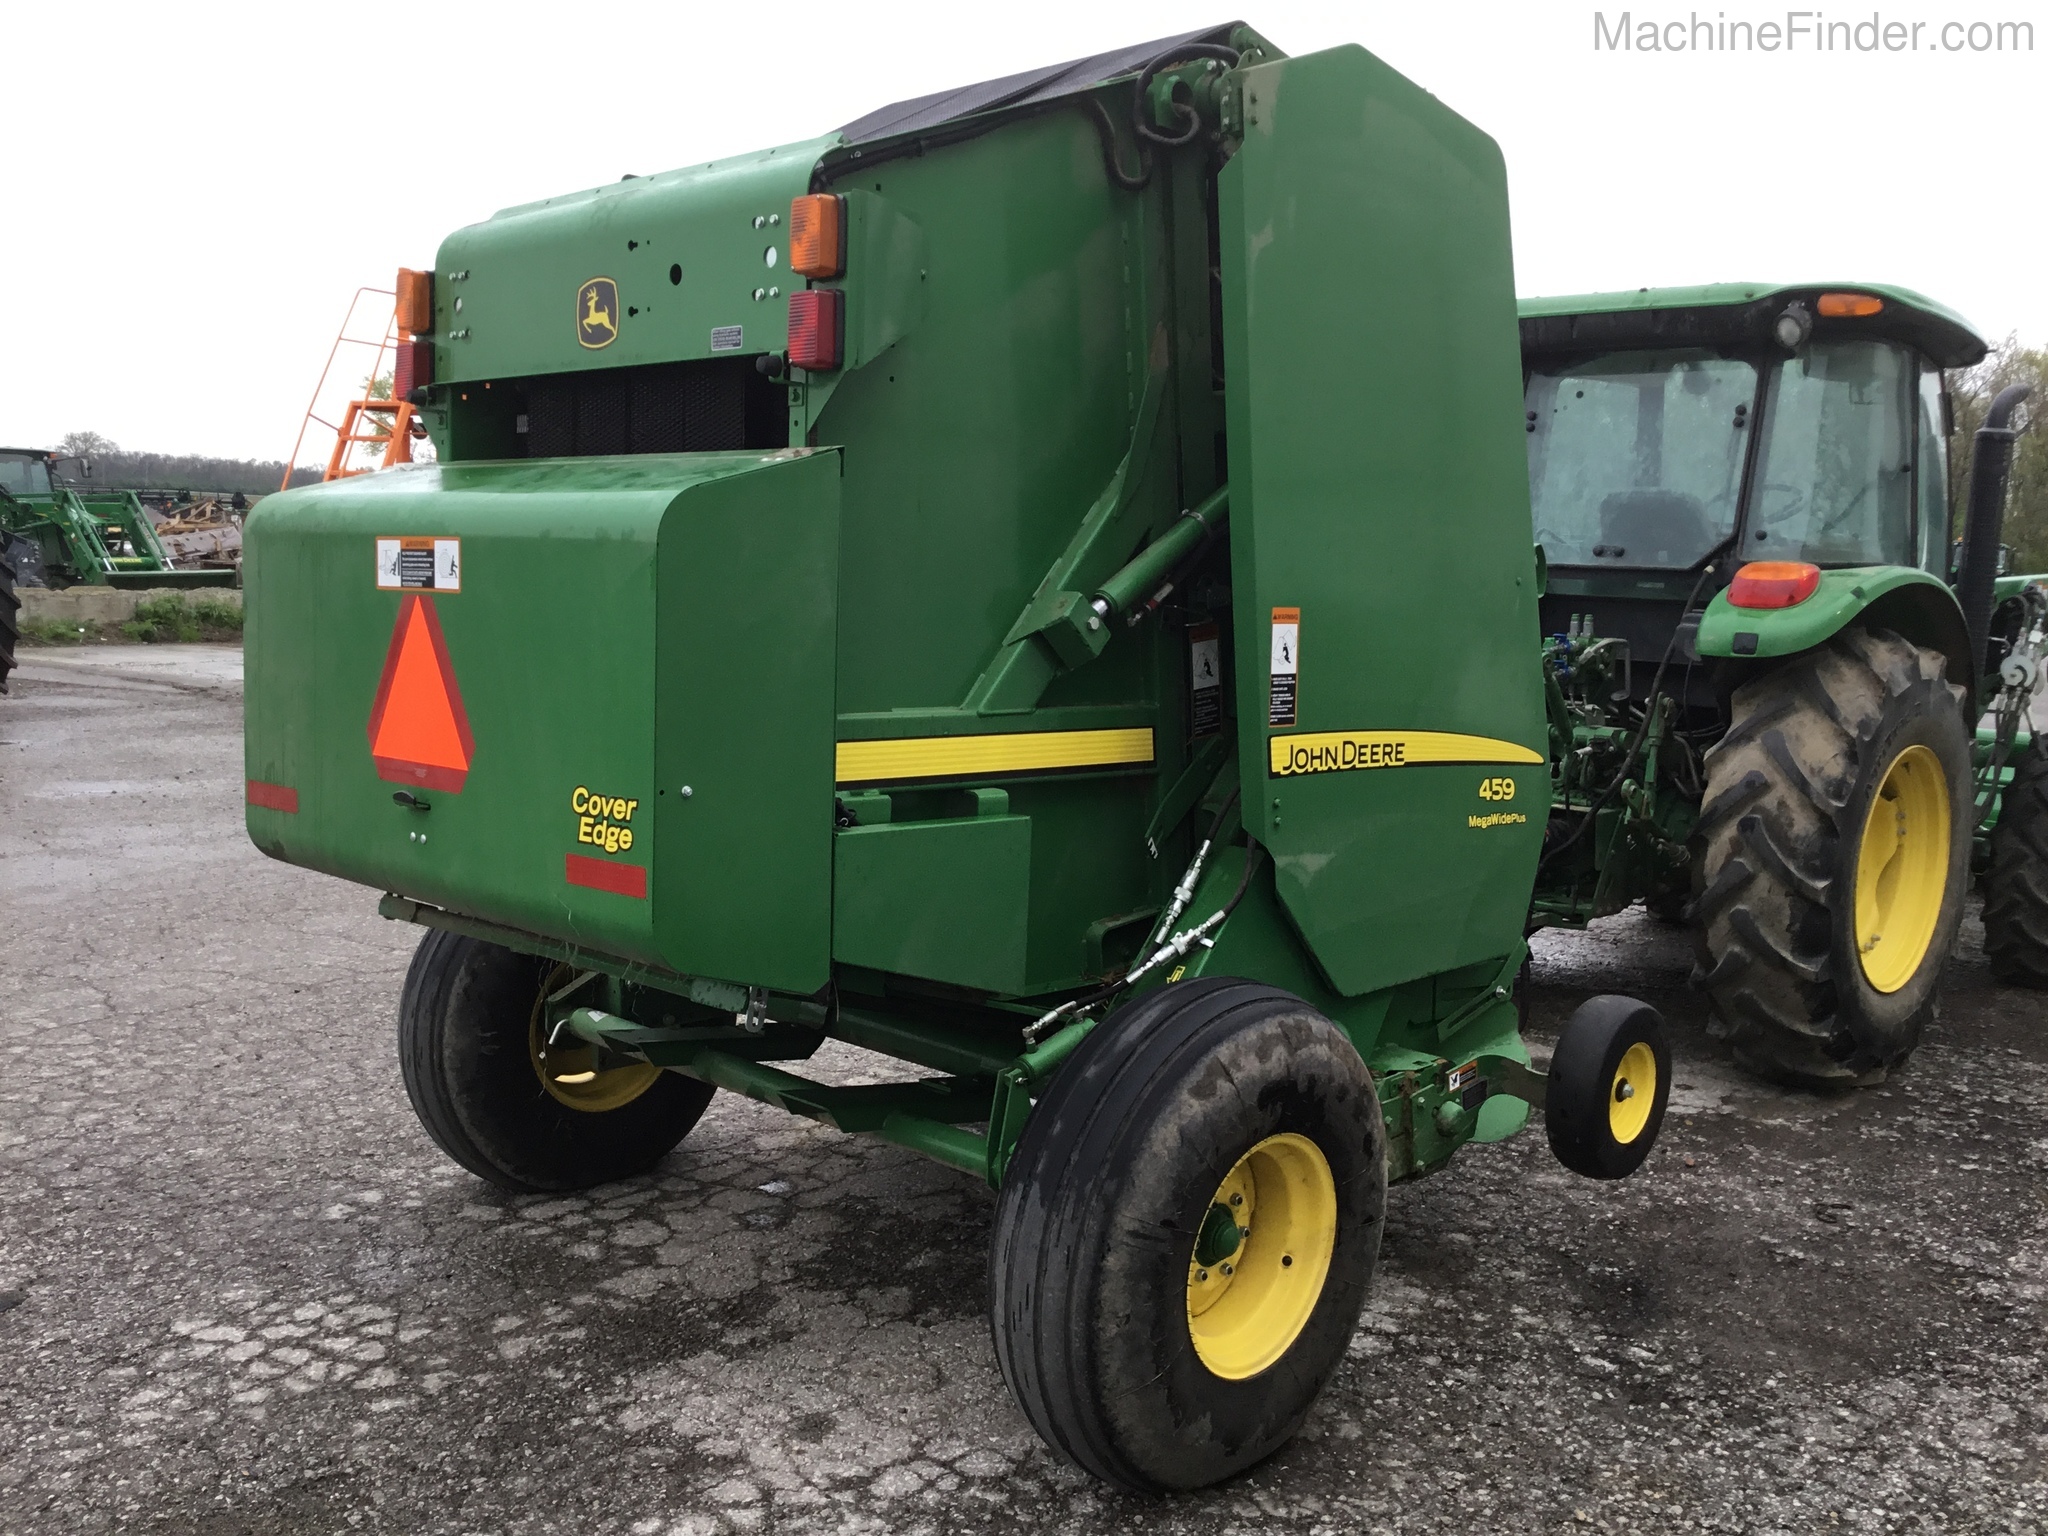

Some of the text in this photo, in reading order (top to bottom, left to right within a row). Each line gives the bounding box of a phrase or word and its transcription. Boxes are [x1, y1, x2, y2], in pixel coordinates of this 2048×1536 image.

[1282, 740, 1406, 771] JOHN DEERE
[572, 786, 638, 822] Cover
[1478, 777, 1516, 801] 459
[578, 815, 633, 853] Edge
[1468, 812, 1527, 829] MegaWidePlus
